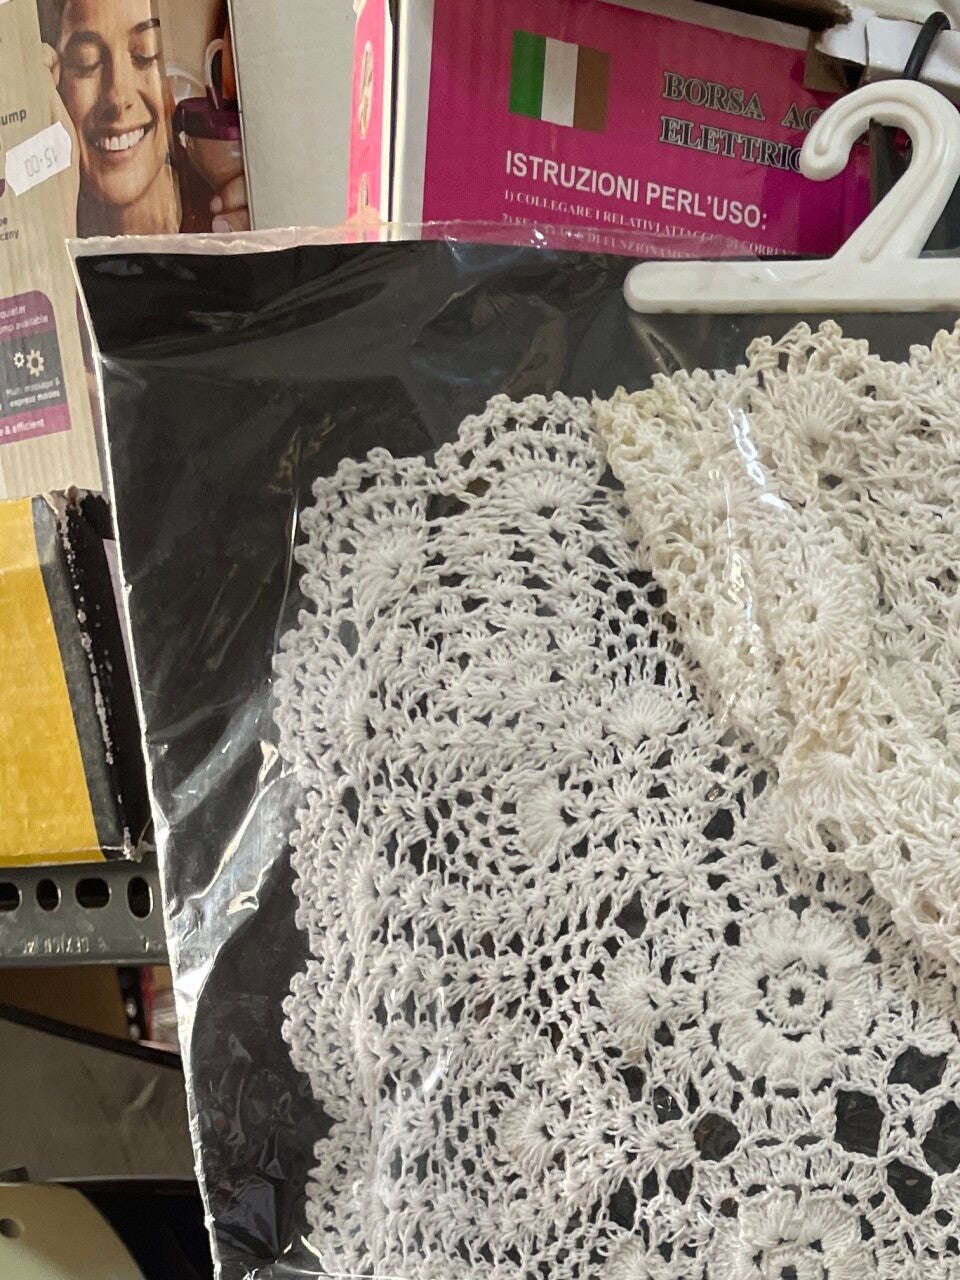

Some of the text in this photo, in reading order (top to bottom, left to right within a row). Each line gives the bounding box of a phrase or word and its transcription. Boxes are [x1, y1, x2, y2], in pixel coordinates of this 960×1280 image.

[662, 71, 766, 122] BORSA
[505, 149, 768, 230] ISTRUZIONI PERL'USO:
[516, 192, 593, 218] COLLEGARE
